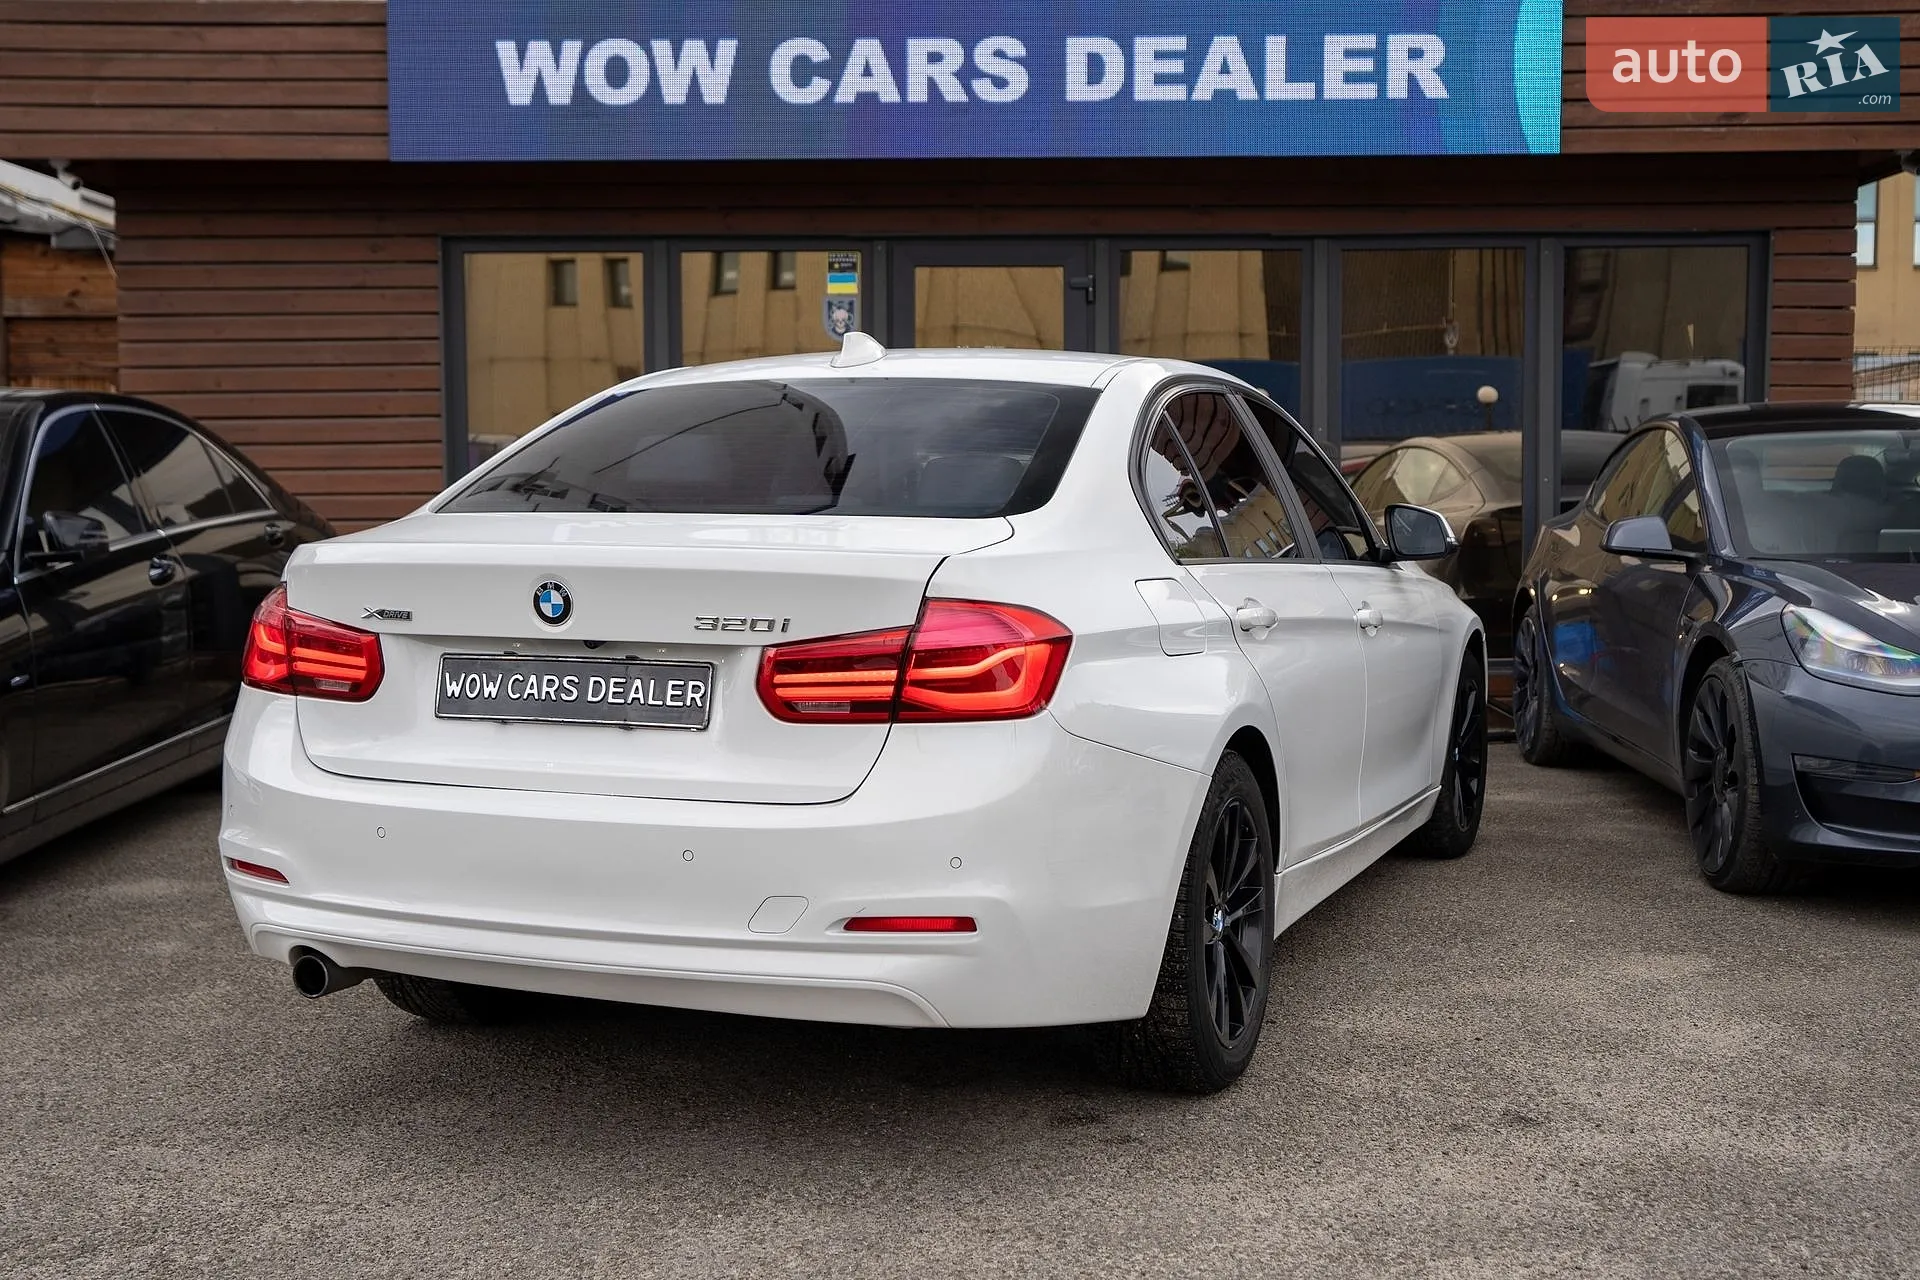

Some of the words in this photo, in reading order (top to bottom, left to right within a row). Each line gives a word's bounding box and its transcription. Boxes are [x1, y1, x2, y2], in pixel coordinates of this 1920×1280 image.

[495, 38, 738, 107] WOW
[769, 36, 1030, 105] CARS
[1065, 33, 1450, 102] DEALER
[536, 582, 568, 597] BMW
[694, 615, 791, 633] 320i
[444, 672, 503, 700] WOW
[507, 673, 579, 703] CARS
[586, 676, 706, 708] DEALER
